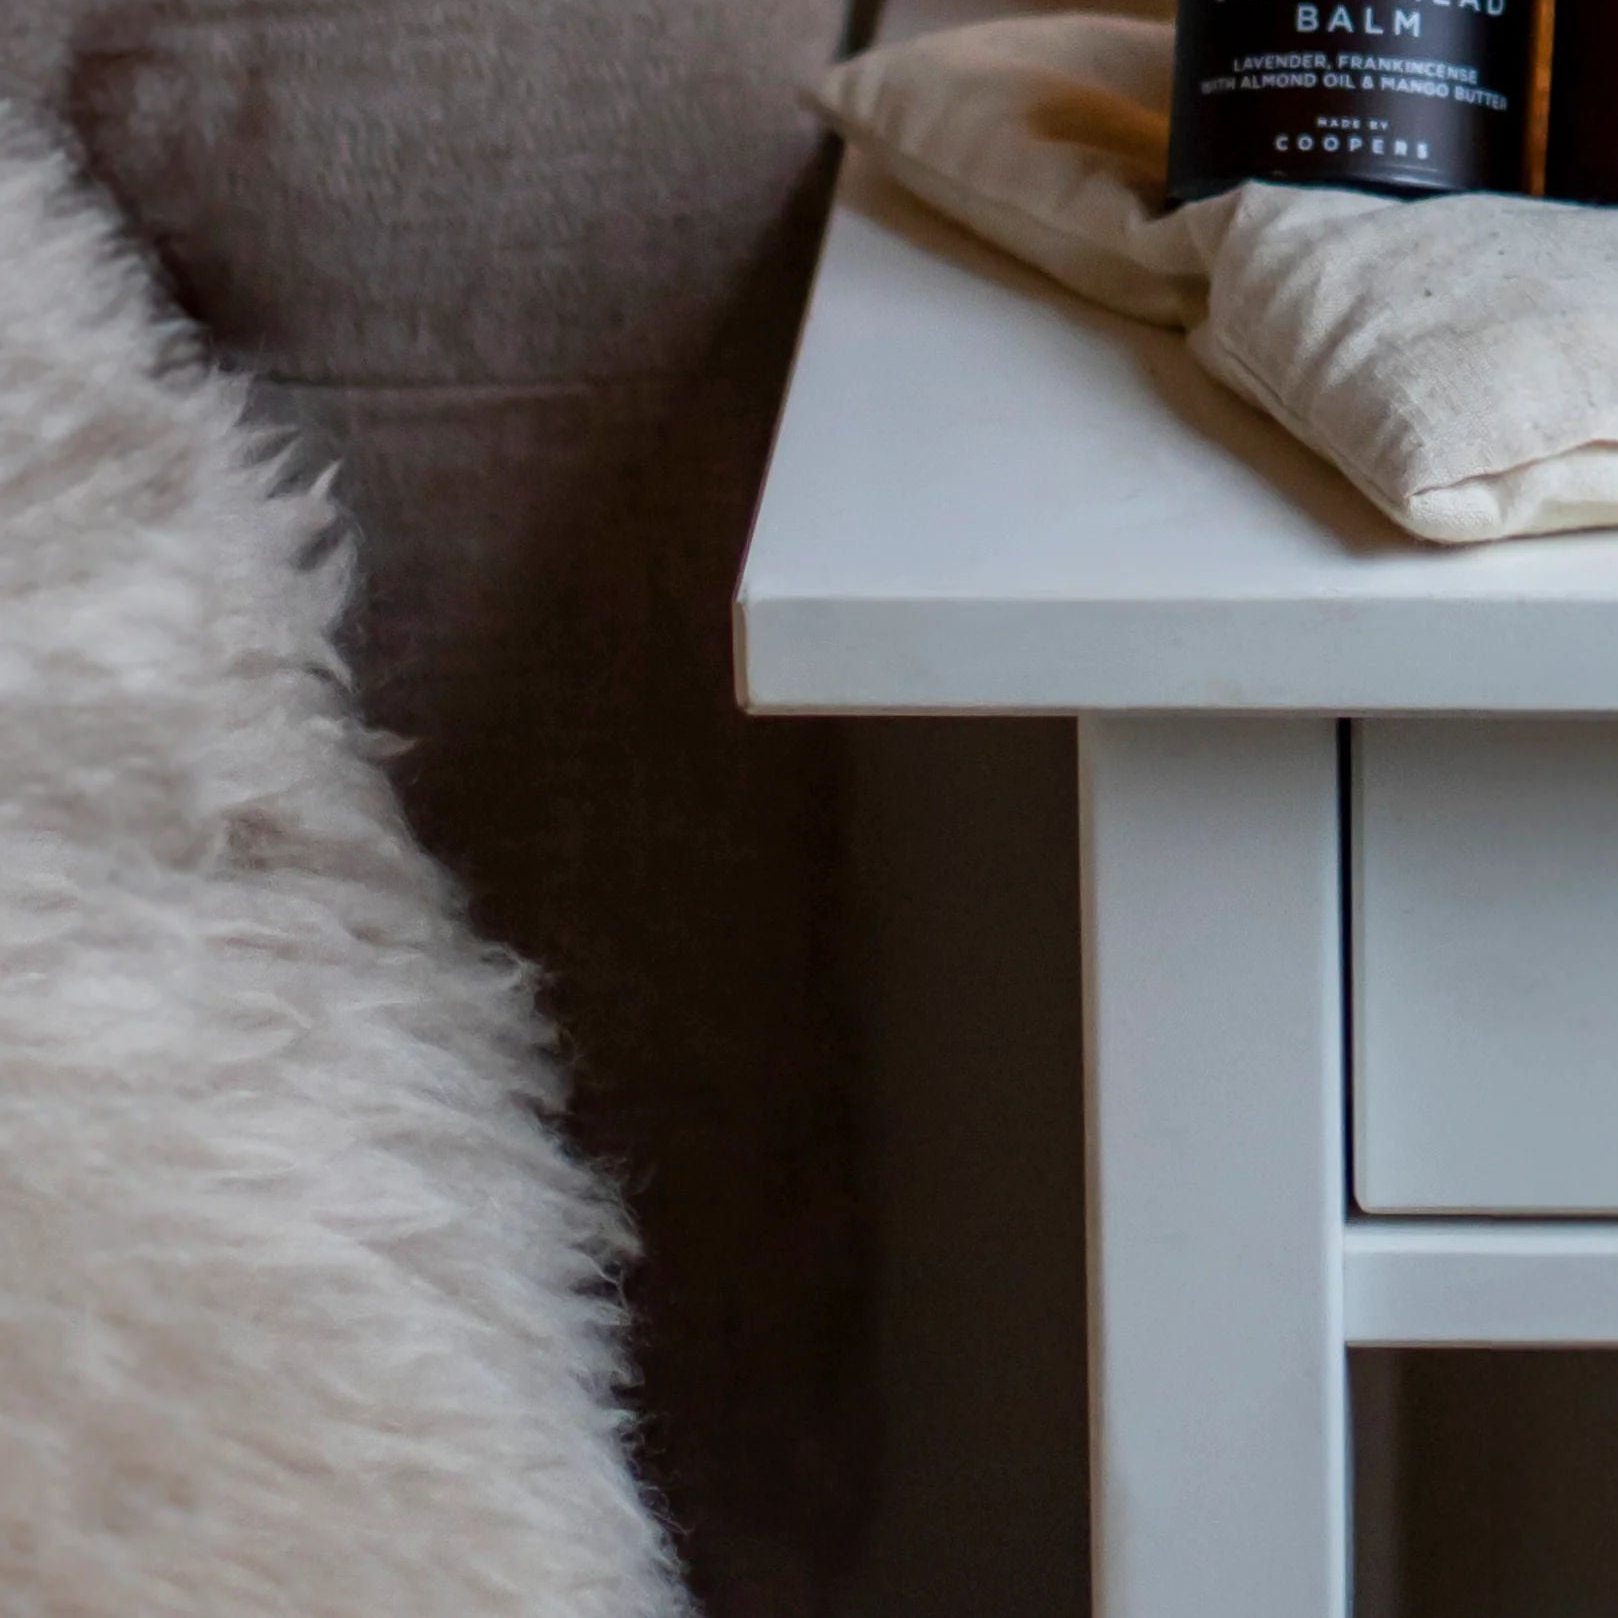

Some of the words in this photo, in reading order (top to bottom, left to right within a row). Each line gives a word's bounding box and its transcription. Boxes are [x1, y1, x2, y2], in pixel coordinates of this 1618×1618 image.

[1296, 4, 1421, 38] BALM
[1233, 53, 1332, 73] LAVENDER,
[1338, 54, 1478, 85] FRANKINCENSE
[1240, 73, 1317, 89] ALMOND
[1323, 73, 1356, 89] OIL
[1380, 76, 1449, 98] MANGO
[1274, 135, 1430, 160] COOPERS
